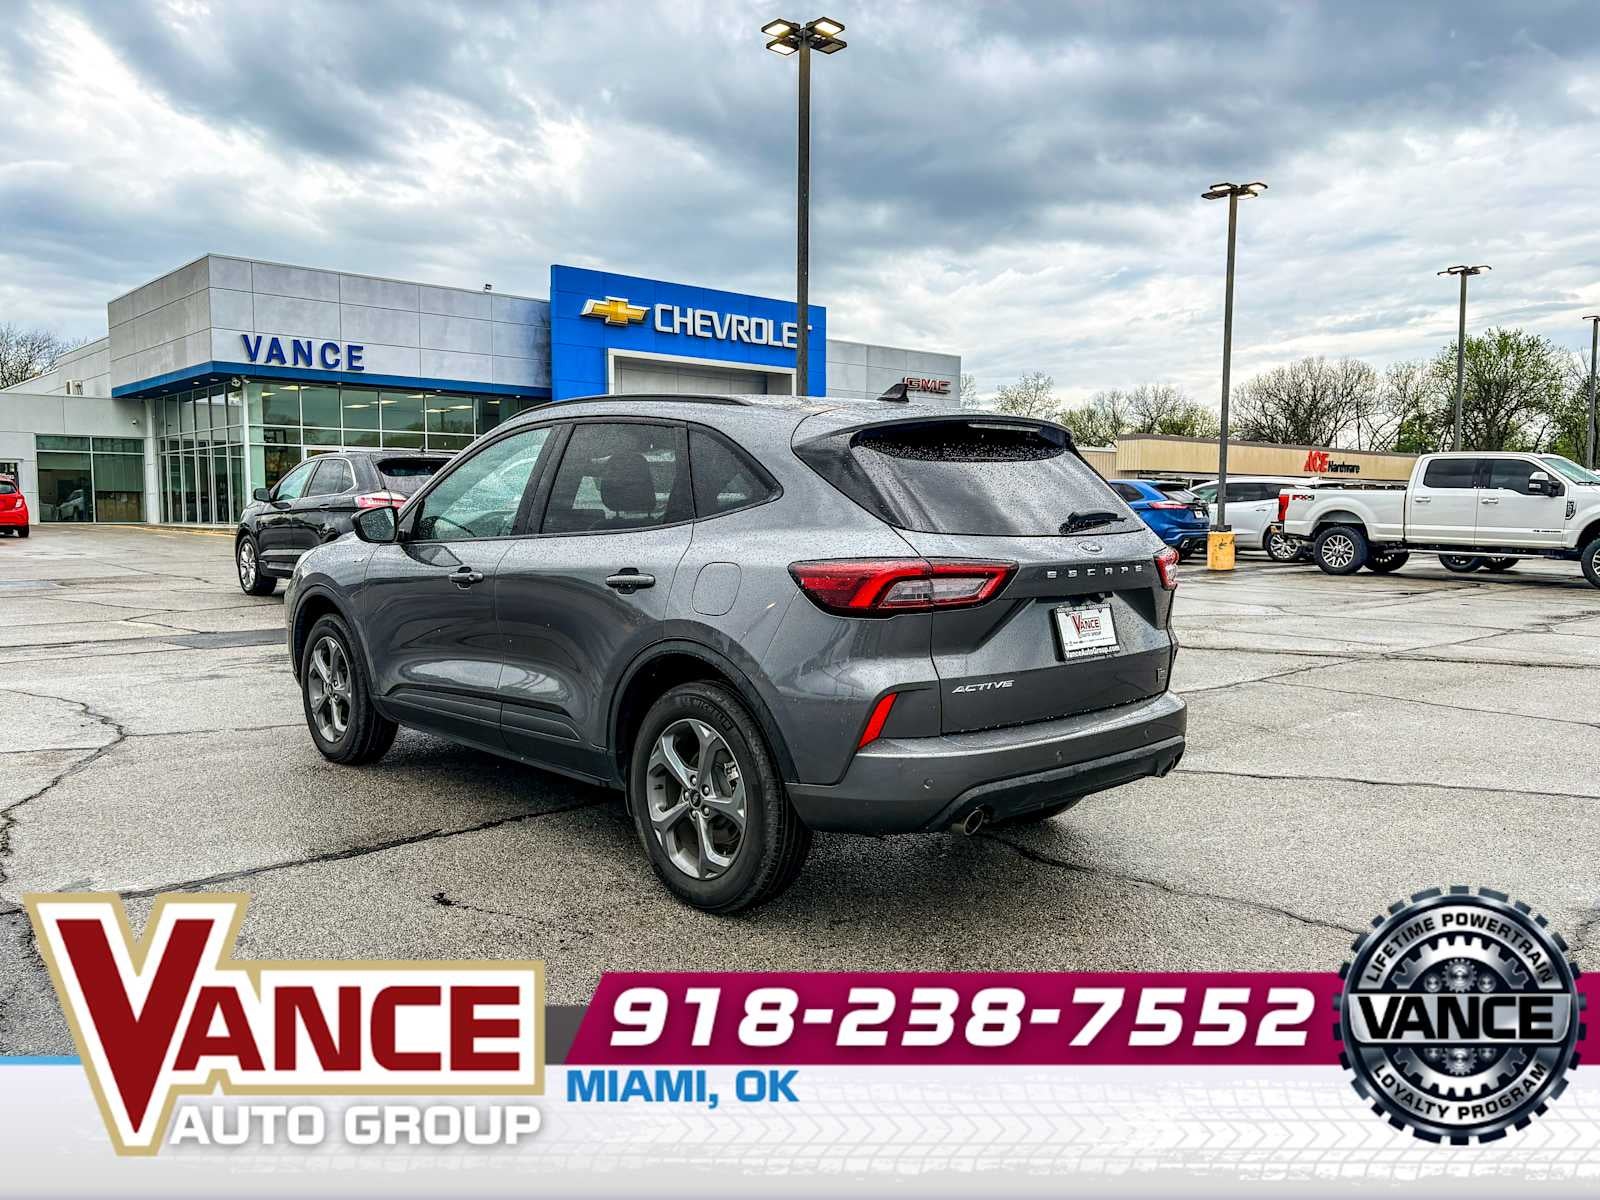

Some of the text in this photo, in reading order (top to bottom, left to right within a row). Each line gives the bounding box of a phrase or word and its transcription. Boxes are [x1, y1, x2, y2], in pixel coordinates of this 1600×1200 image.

[241, 334, 365, 372] VANCE
[902, 376, 952, 395] GMC
[1303, 448, 1361, 474] ACE Hardware
[1046, 564, 1144, 579] ESCAPE
[1071, 611, 1101, 636] VANCE
[951, 679, 1016, 695] ACTIVE
